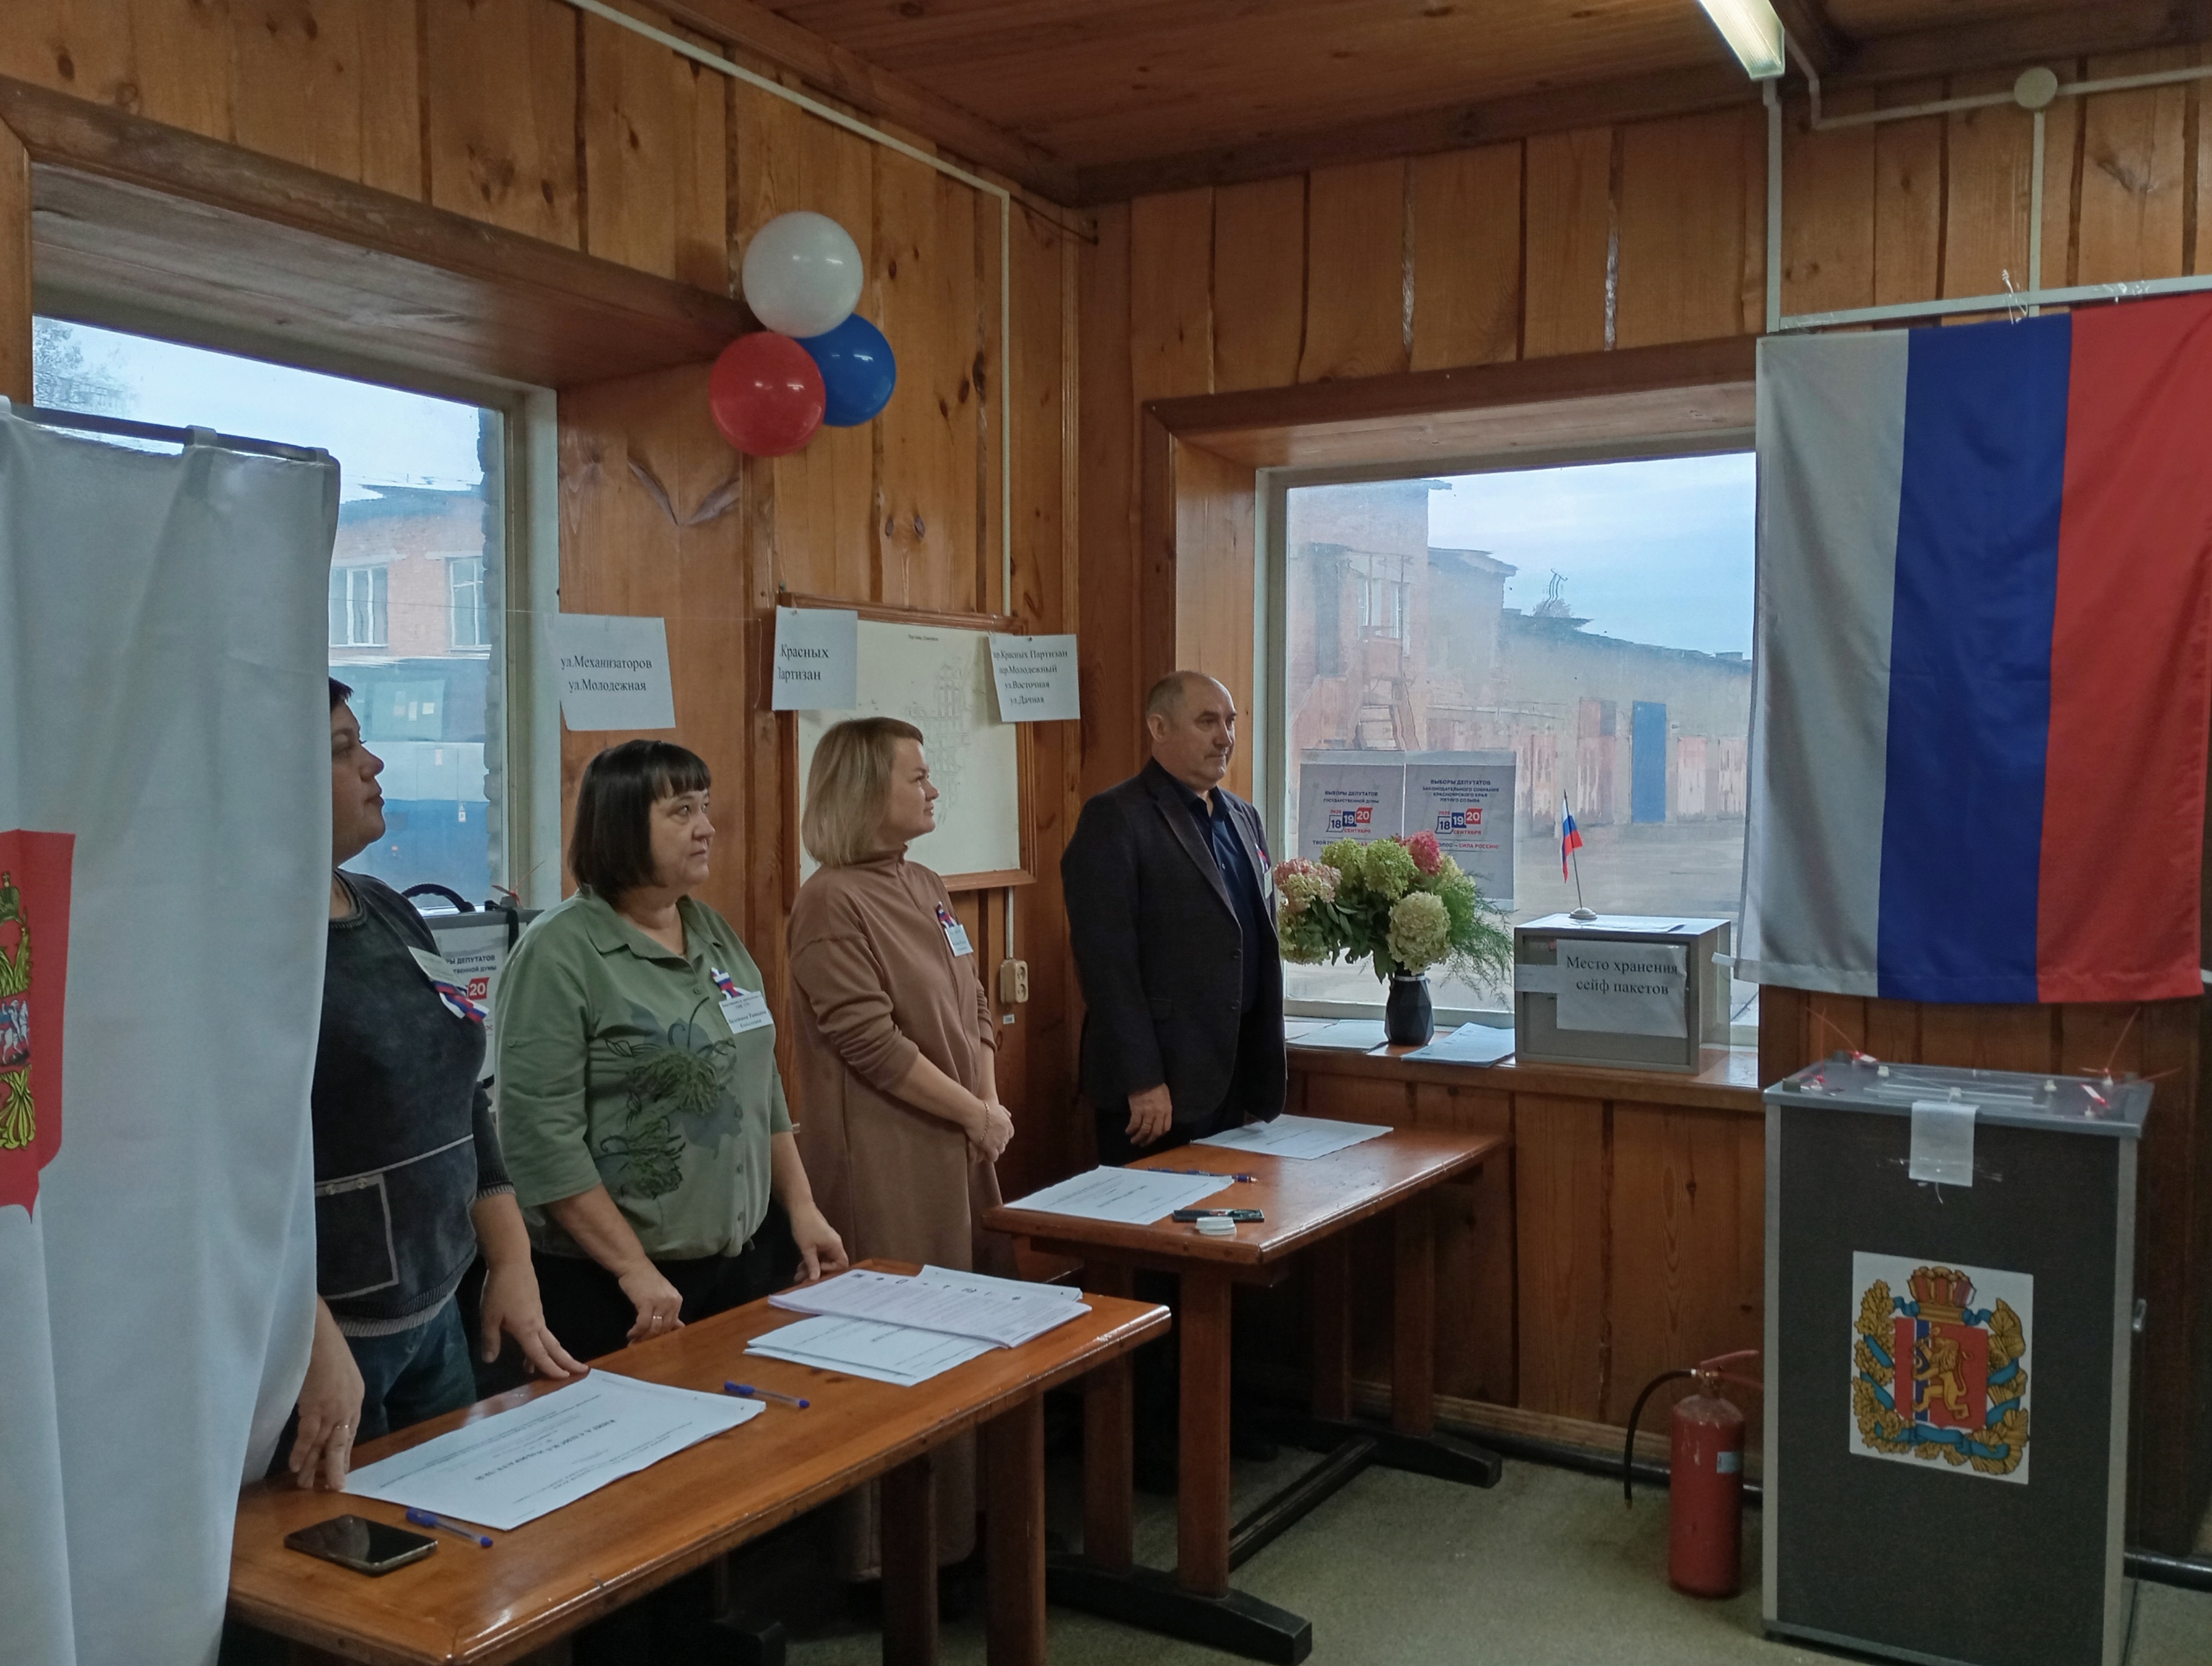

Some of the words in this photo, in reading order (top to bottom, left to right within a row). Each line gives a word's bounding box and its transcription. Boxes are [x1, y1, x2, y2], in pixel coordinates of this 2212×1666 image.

[561, 655, 652, 672] ул.Механизаторов
[1030, 650, 1068, 661] Партизан
[568, 678, 646, 693] ул.Молодежная
[1331, 819, 1341, 829] 18
[1343, 815, 1354, 824] 19
[1356, 811, 1369, 820] 20
[1439, 821, 1450, 830] 18
[1452, 816, 1464, 825] 19
[1466, 812, 1480, 822] 20
[456, 954, 496, 965] ДЕПУТАТОВ
[1566, 956, 1610, 971] Место
[1613, 961, 1678, 975] хранения
[468, 984, 486, 997] 20
[1576, 979, 1610, 994] сейф
[1613, 984, 1669, 995] пакетов
